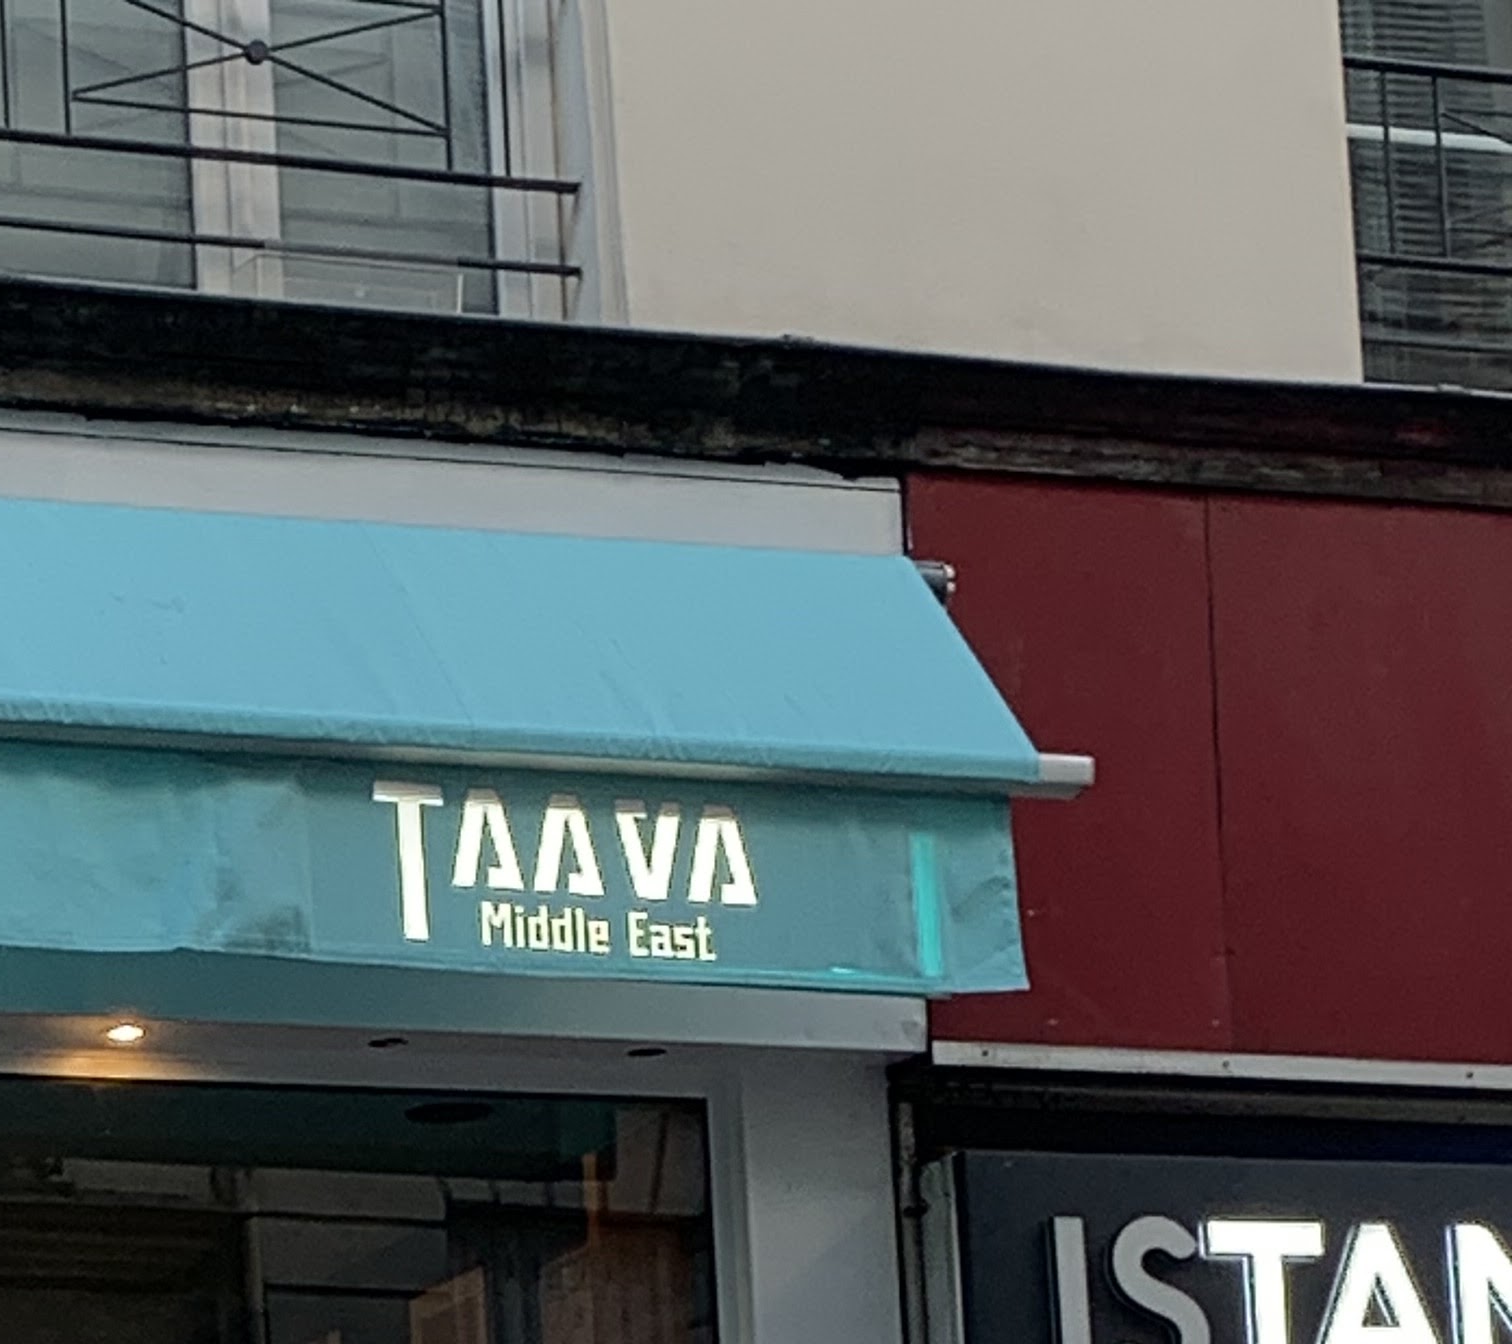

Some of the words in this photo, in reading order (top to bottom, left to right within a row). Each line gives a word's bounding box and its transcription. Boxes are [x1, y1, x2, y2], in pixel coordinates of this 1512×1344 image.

[372, 780, 758, 943] TAAVA
[481, 900, 611, 957] Middle
[628, 911, 717, 961] East
